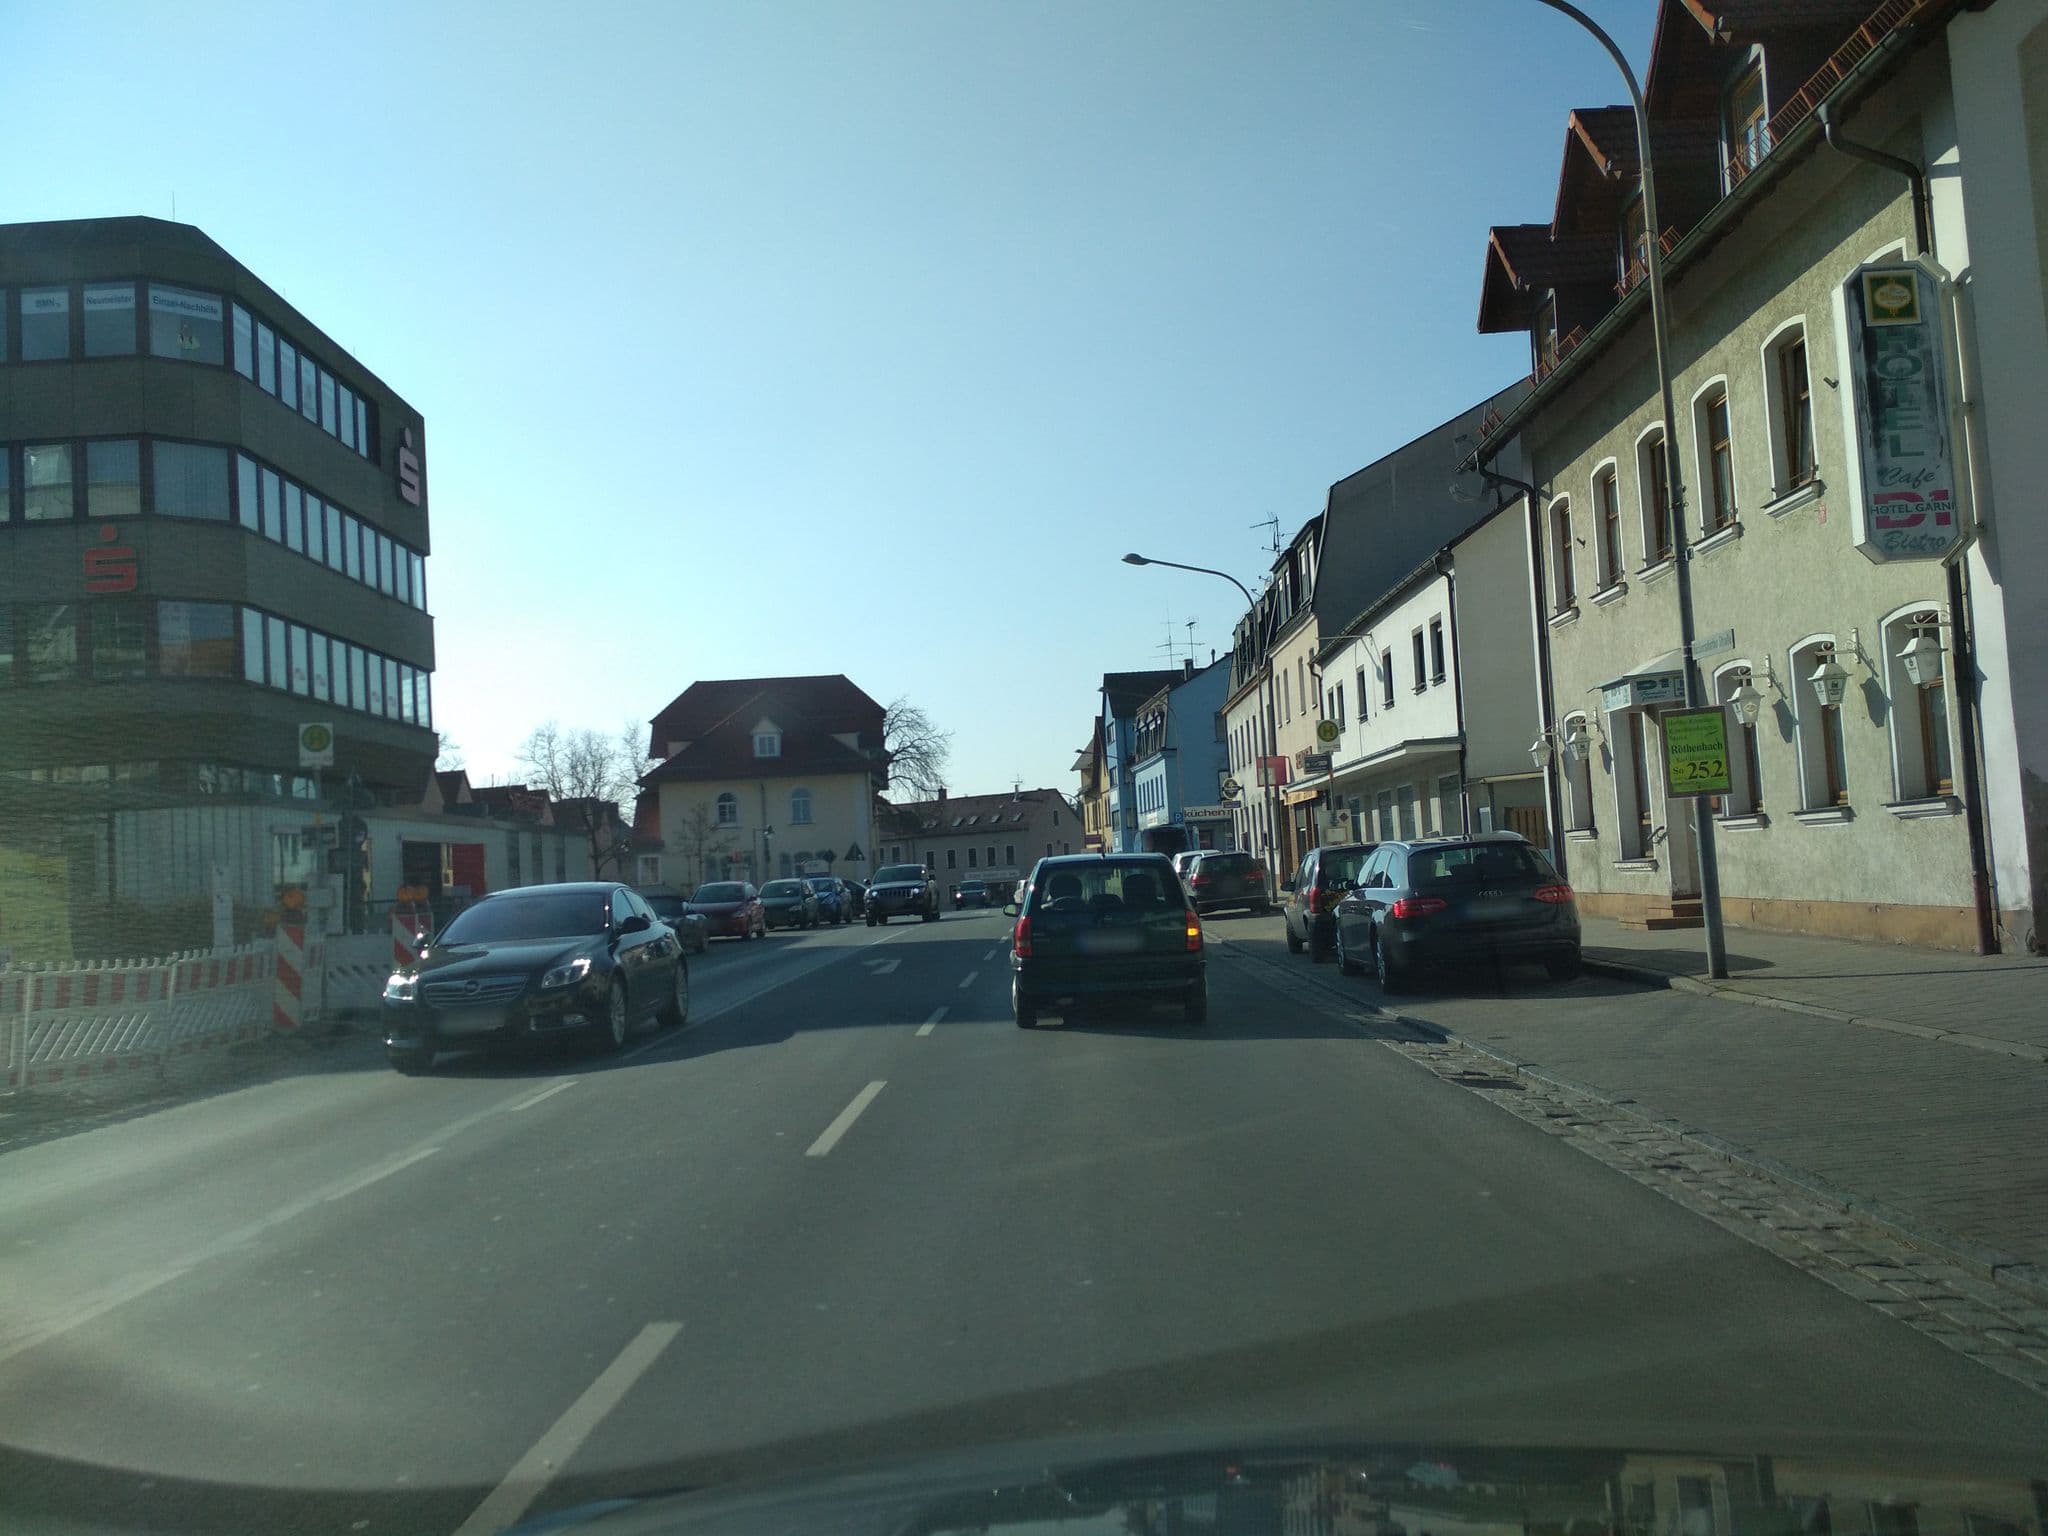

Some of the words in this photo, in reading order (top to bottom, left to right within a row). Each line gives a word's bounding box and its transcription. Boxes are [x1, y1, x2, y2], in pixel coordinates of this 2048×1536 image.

[1880, 464, 1941, 489] Café
[1871, 503, 1913, 515] HOTEL
[1915, 501, 1956, 513] GARNI
[1883, 530, 1946, 551] Bistro
